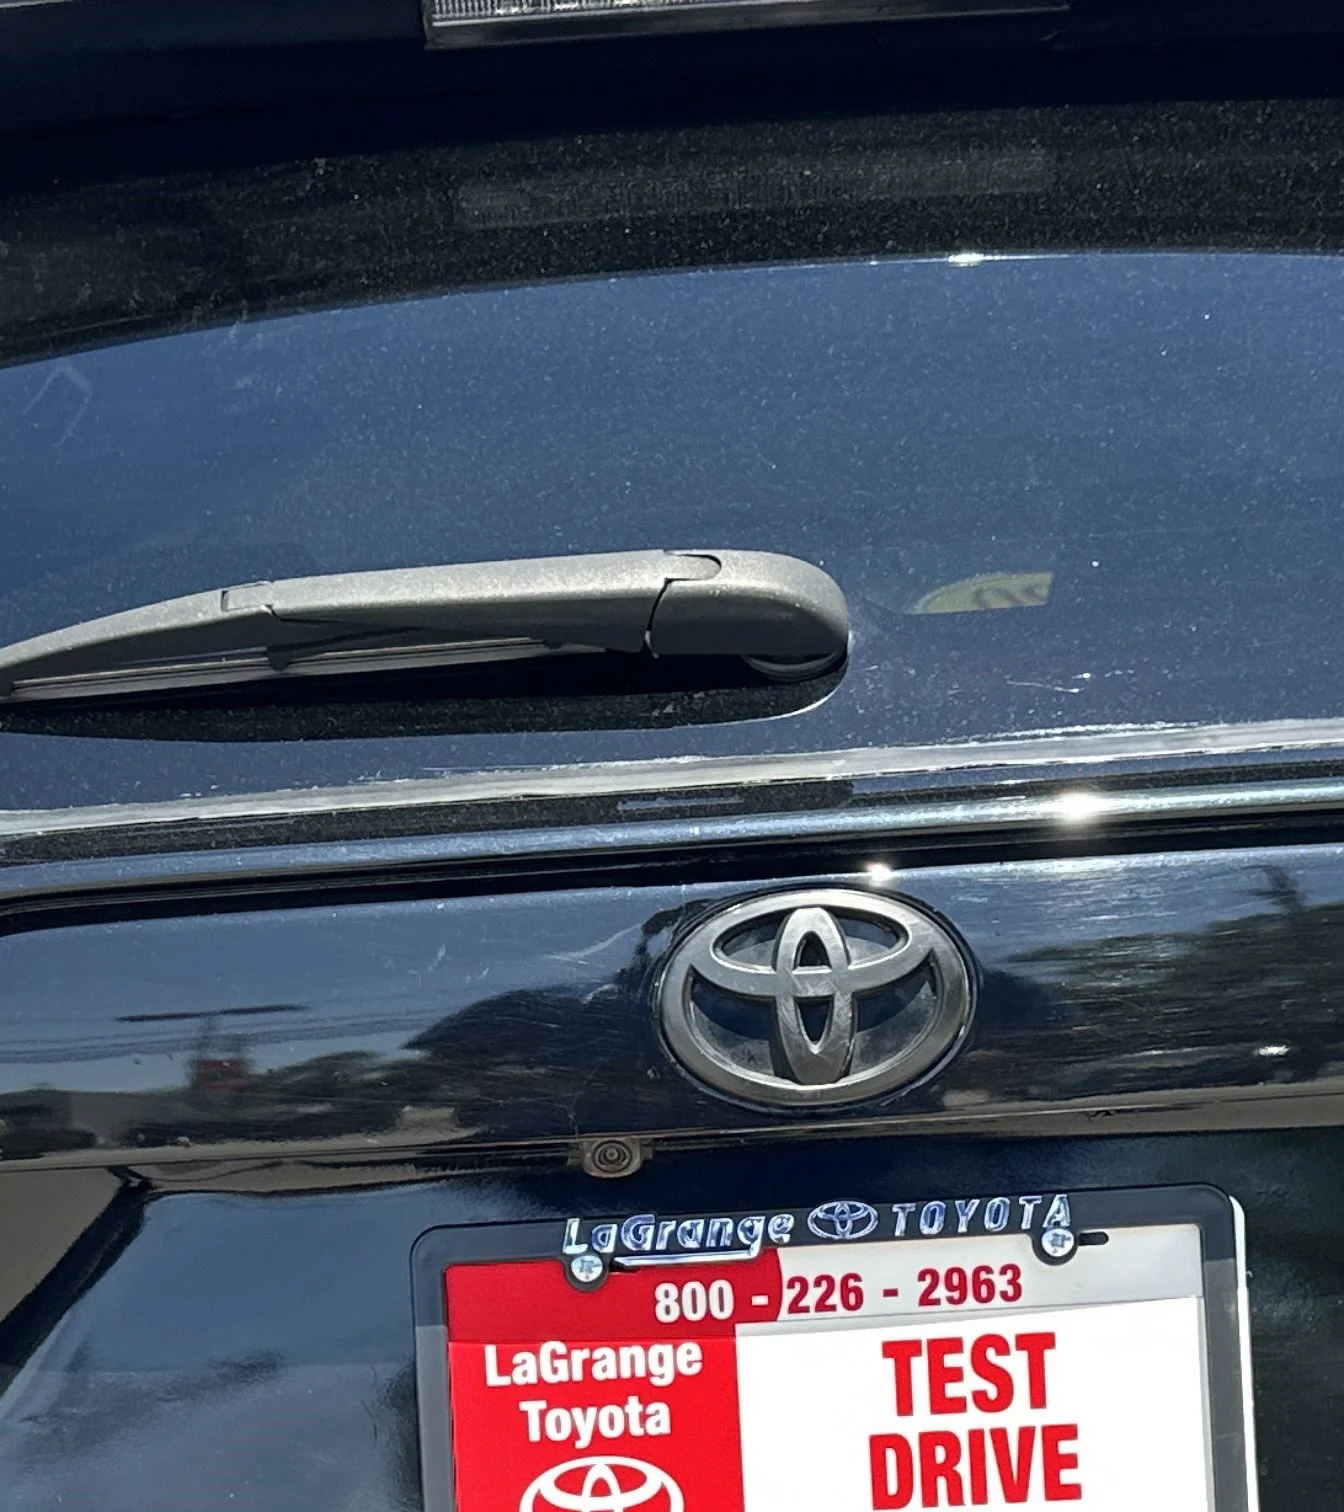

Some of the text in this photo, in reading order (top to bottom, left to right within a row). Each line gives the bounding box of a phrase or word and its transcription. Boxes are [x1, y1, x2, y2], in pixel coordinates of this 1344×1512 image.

[562, 1193, 1072, 1266] LaGrange TOYOTA
[655, 1278, 735, 1324] 800
[786, 1273, 864, 1315] 226
[917, 1263, 1023, 1307] 2963
[485, 1339, 703, 1388] LaGrange
[882, 1331, 1056, 1418] TEST
[519, 1395, 671, 1450] Toyota
[869, 1424, 1083, 1511] DRIVE
